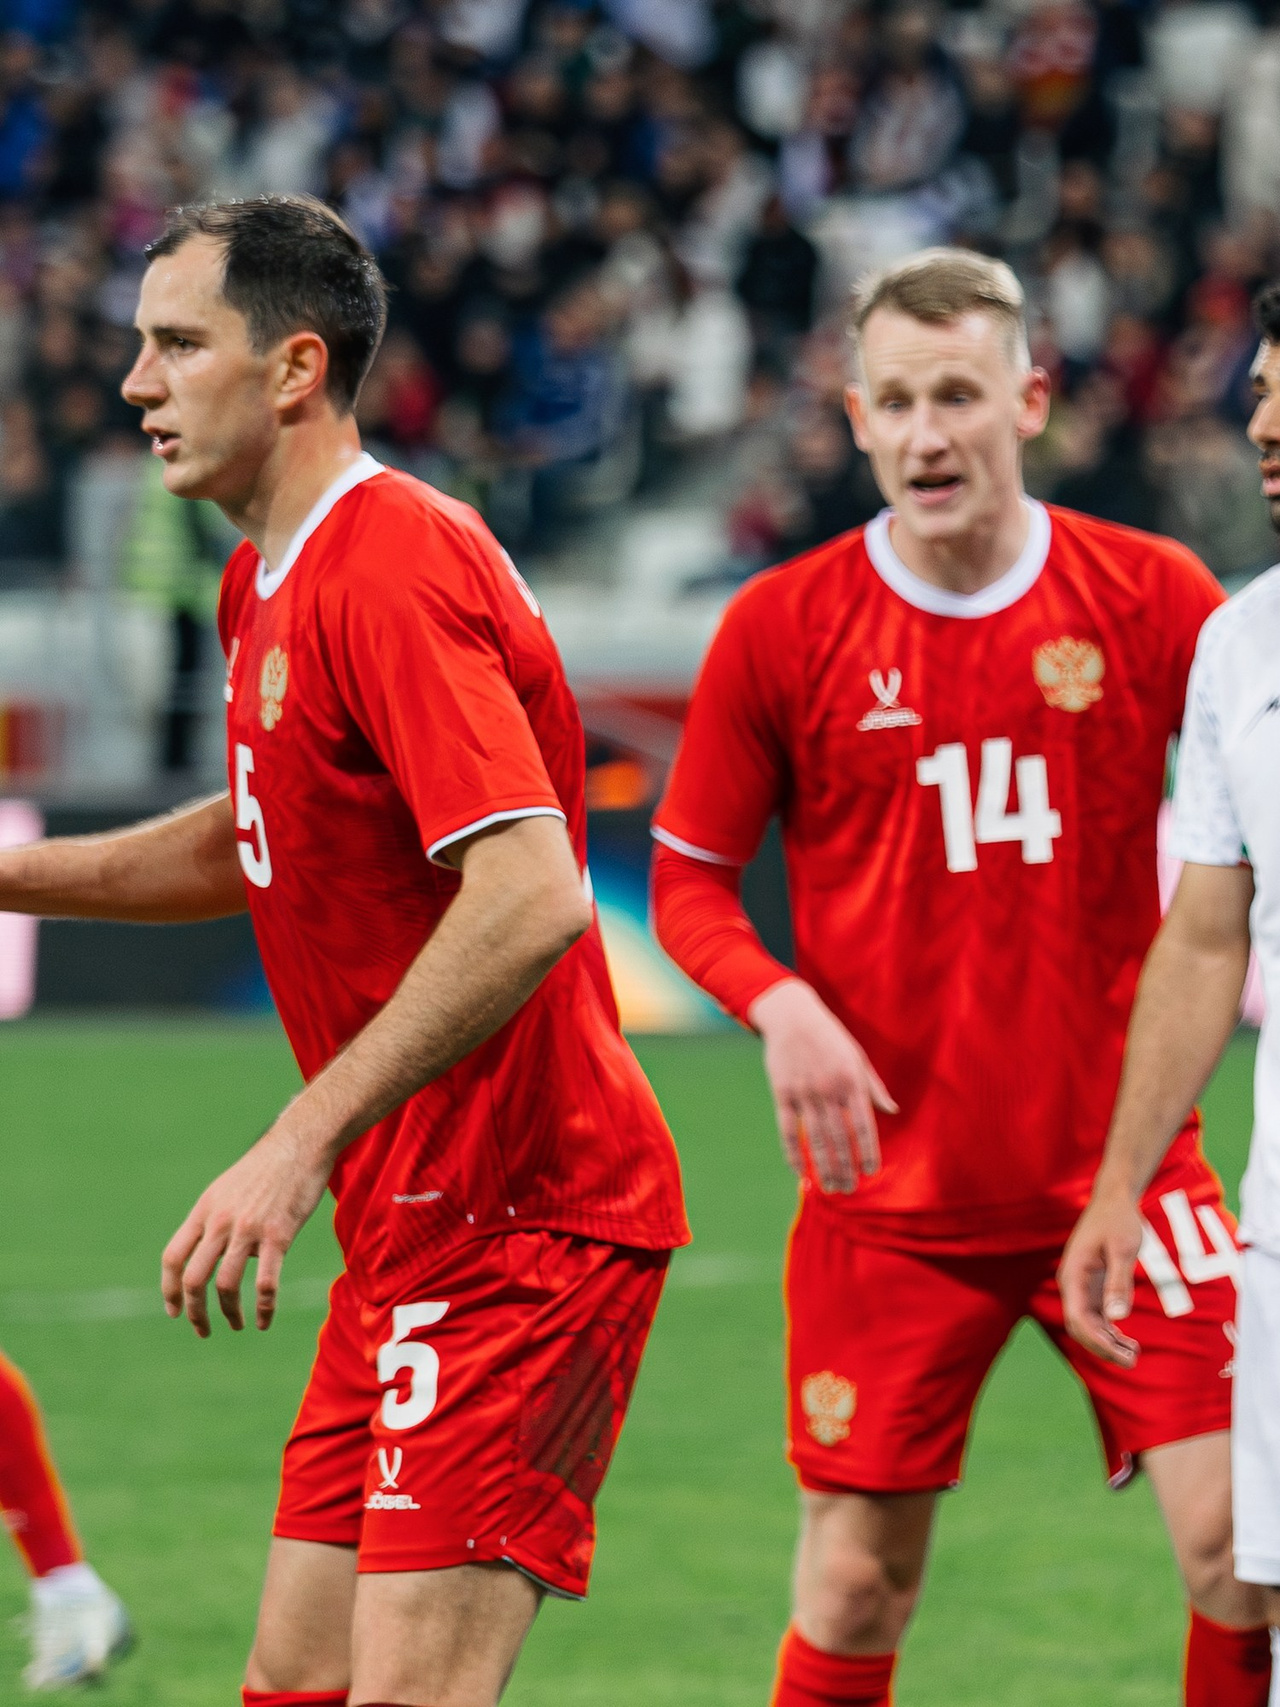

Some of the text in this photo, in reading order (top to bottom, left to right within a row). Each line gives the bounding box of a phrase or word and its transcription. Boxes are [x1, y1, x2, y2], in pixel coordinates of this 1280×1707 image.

[235, 742, 272, 888] 5
[917, 737, 1062, 872] 14
[1138, 1188, 1242, 1318] 14
[377, 1301, 450, 1430] 5
